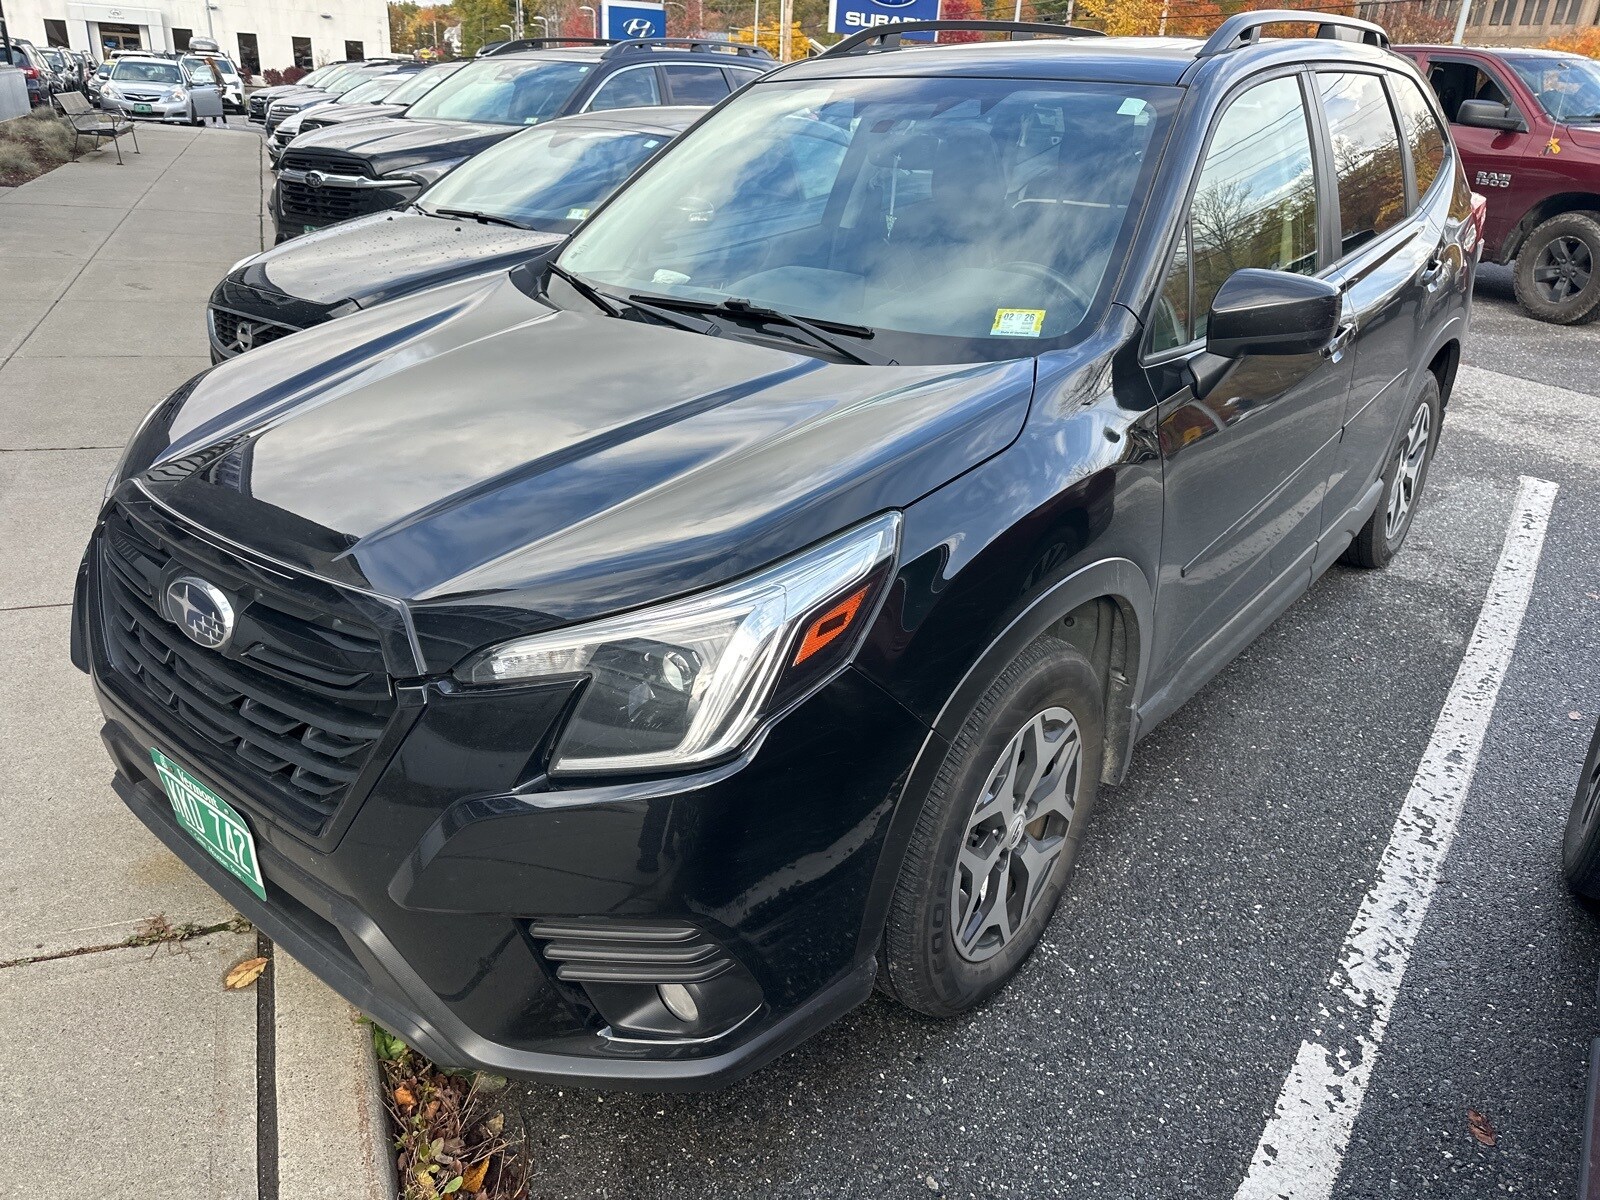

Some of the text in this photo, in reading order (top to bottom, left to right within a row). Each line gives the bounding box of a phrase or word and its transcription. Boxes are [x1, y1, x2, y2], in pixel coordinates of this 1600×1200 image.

[845, 11, 930, 27] SUBA
[1476, 178, 1510, 187] 1500
[1477, 171, 1511, 180] RAM
[177, 768, 219, 808] Vermont
[208, 809, 251, 875] 742
